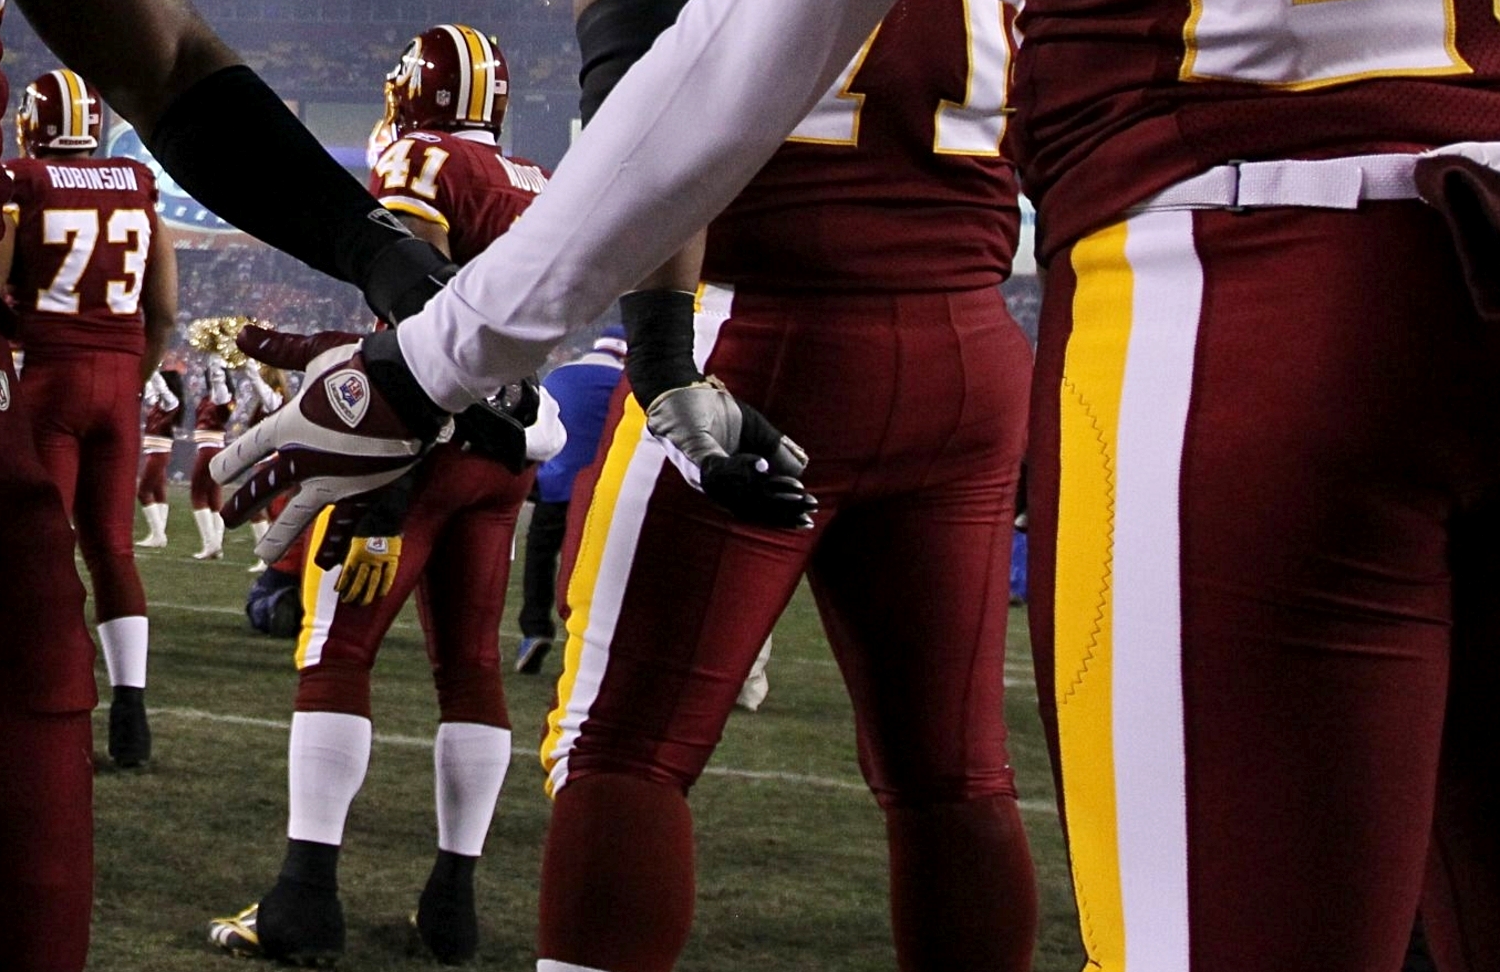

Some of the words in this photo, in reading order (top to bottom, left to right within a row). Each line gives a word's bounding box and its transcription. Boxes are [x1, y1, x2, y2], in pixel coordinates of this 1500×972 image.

[46, 165, 139, 191] ROBINSON
[374, 138, 450, 200] 41
[36, 208, 151, 315] 73
